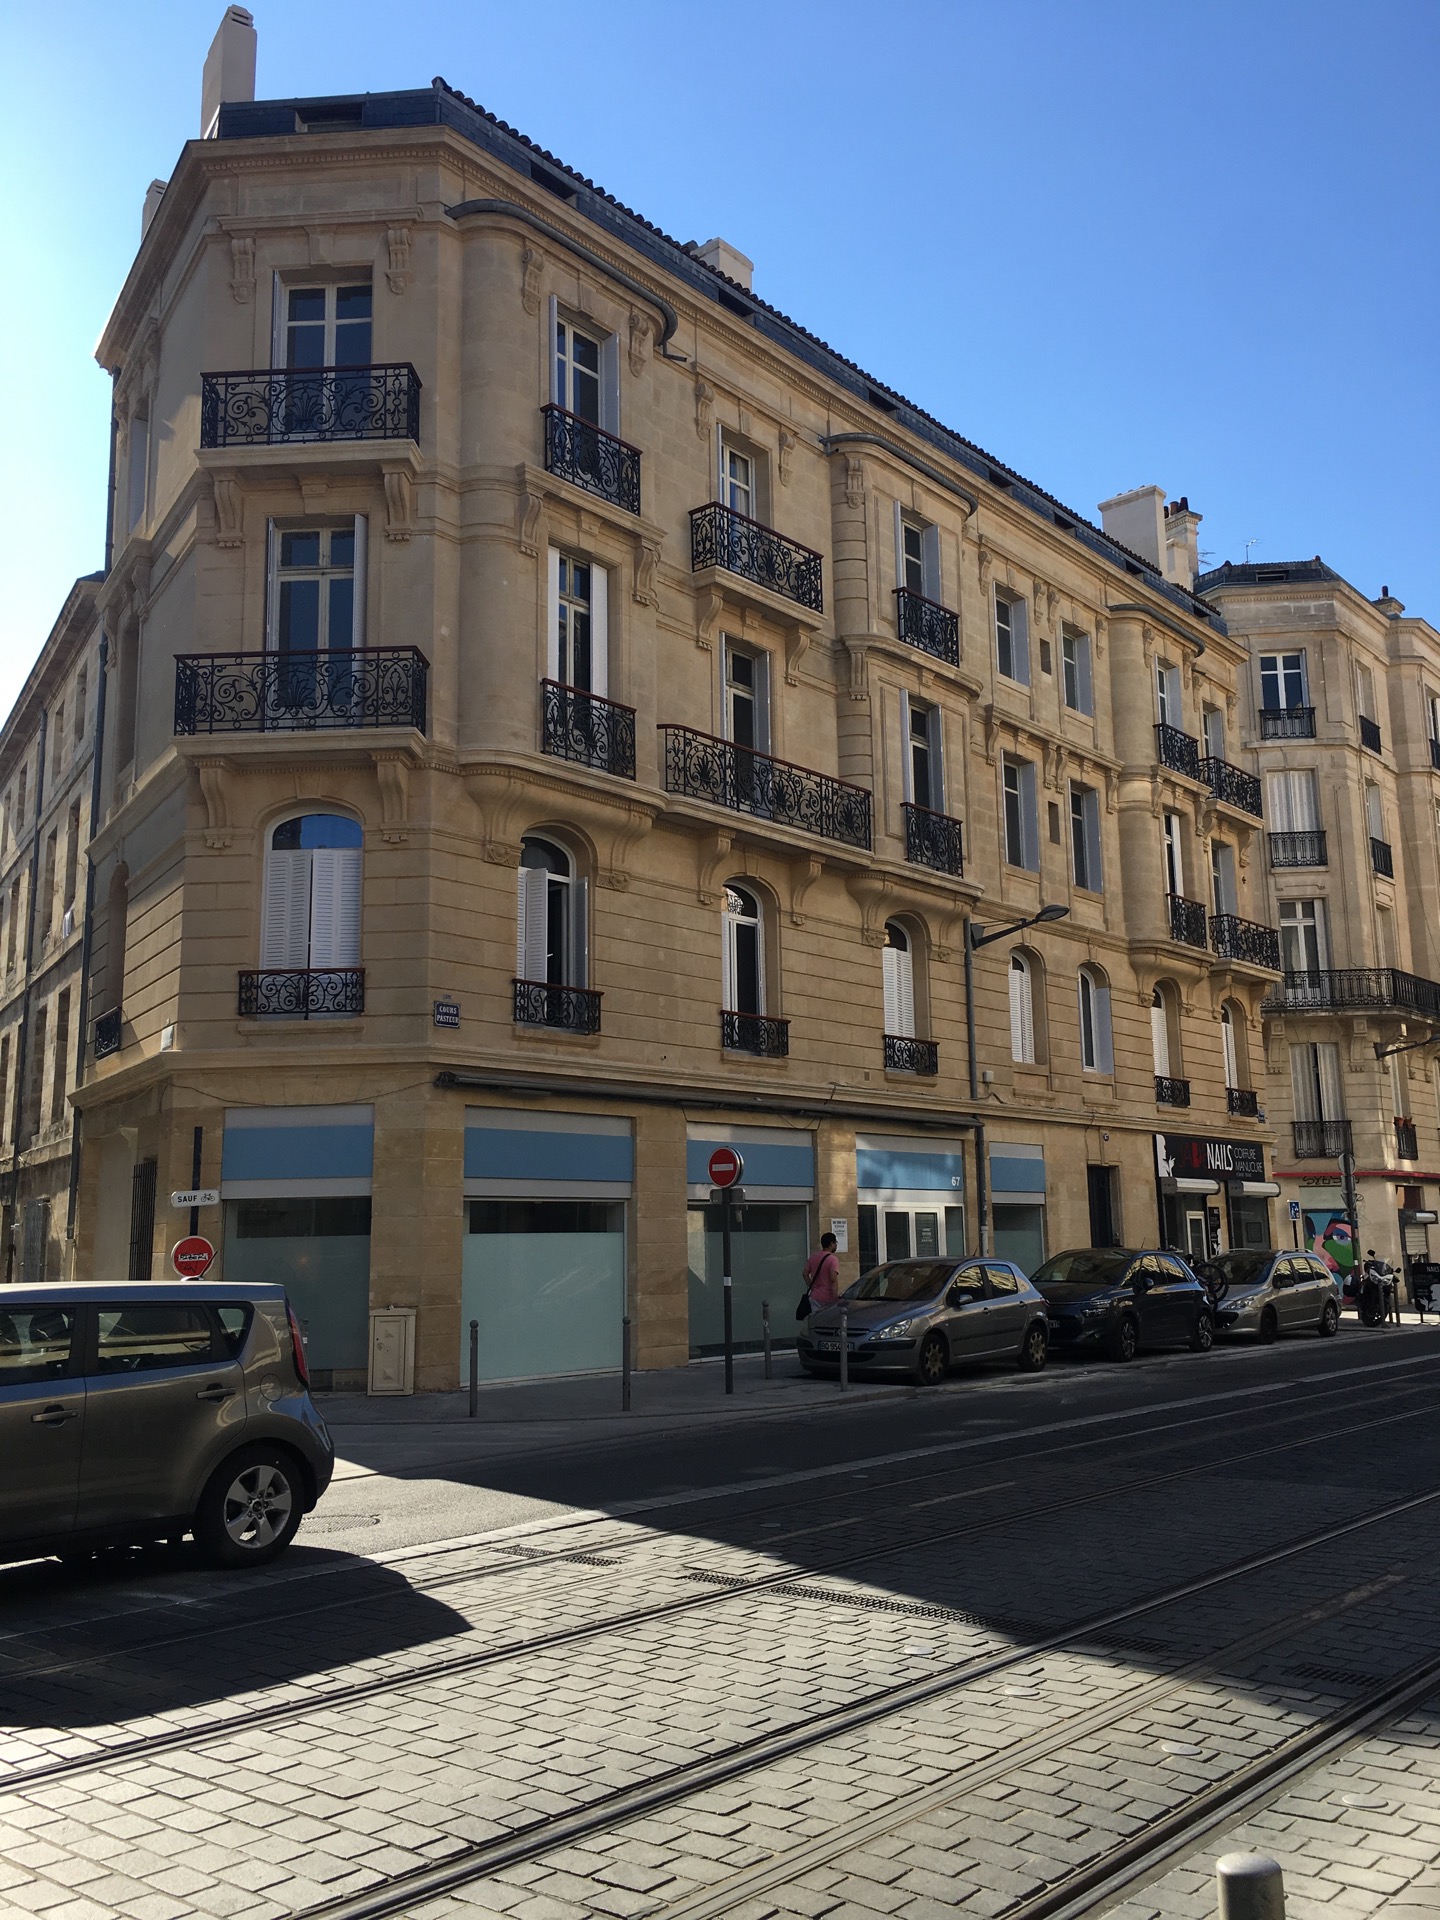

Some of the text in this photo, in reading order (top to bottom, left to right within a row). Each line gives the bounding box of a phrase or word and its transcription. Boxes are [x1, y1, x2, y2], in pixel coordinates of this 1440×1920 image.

[439, 1005, 457, 1014] COURS
[1206, 1142, 1233, 1171] NAILS
[1233, 1147, 1257, 1160] COIFFURE
[951, 1176, 961, 1186] 67
[177, 1194, 198, 1203] SAUF
